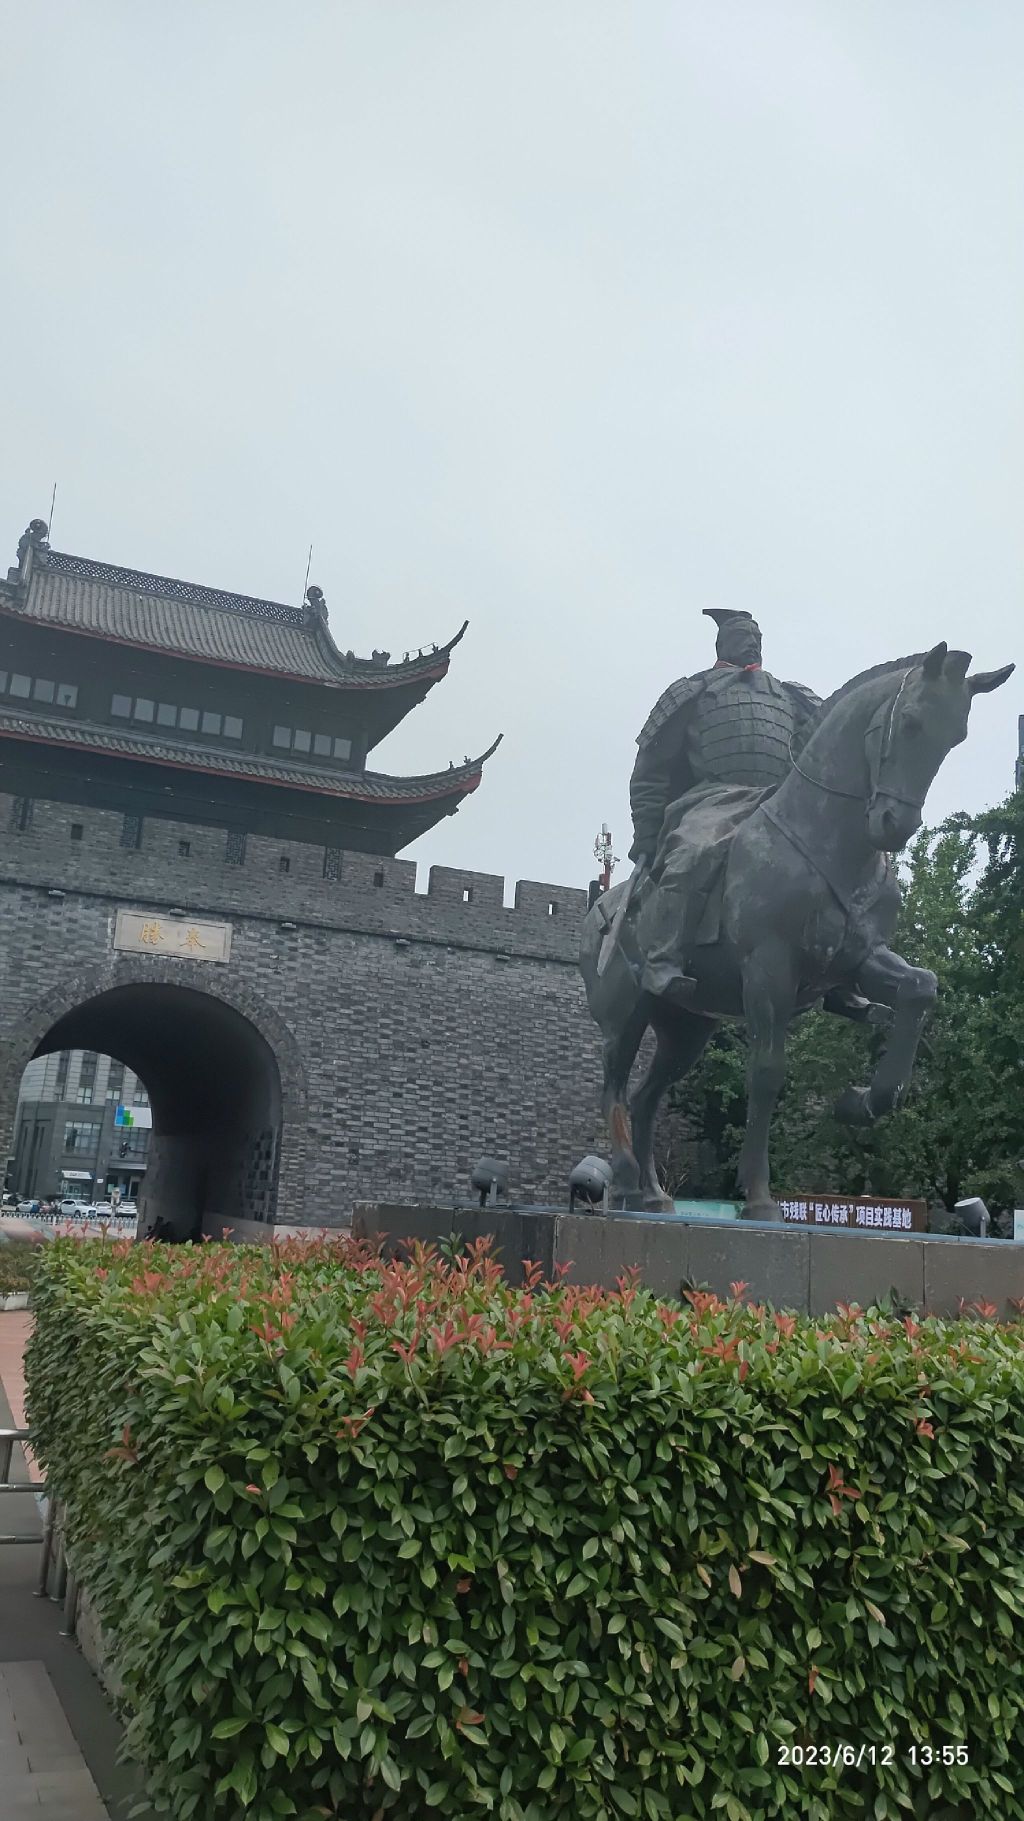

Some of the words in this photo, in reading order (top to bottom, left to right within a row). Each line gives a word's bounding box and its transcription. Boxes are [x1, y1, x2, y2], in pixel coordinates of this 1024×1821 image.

[777, 1200, 912, 1229] 市残联“匠心传承”项目实践基地
